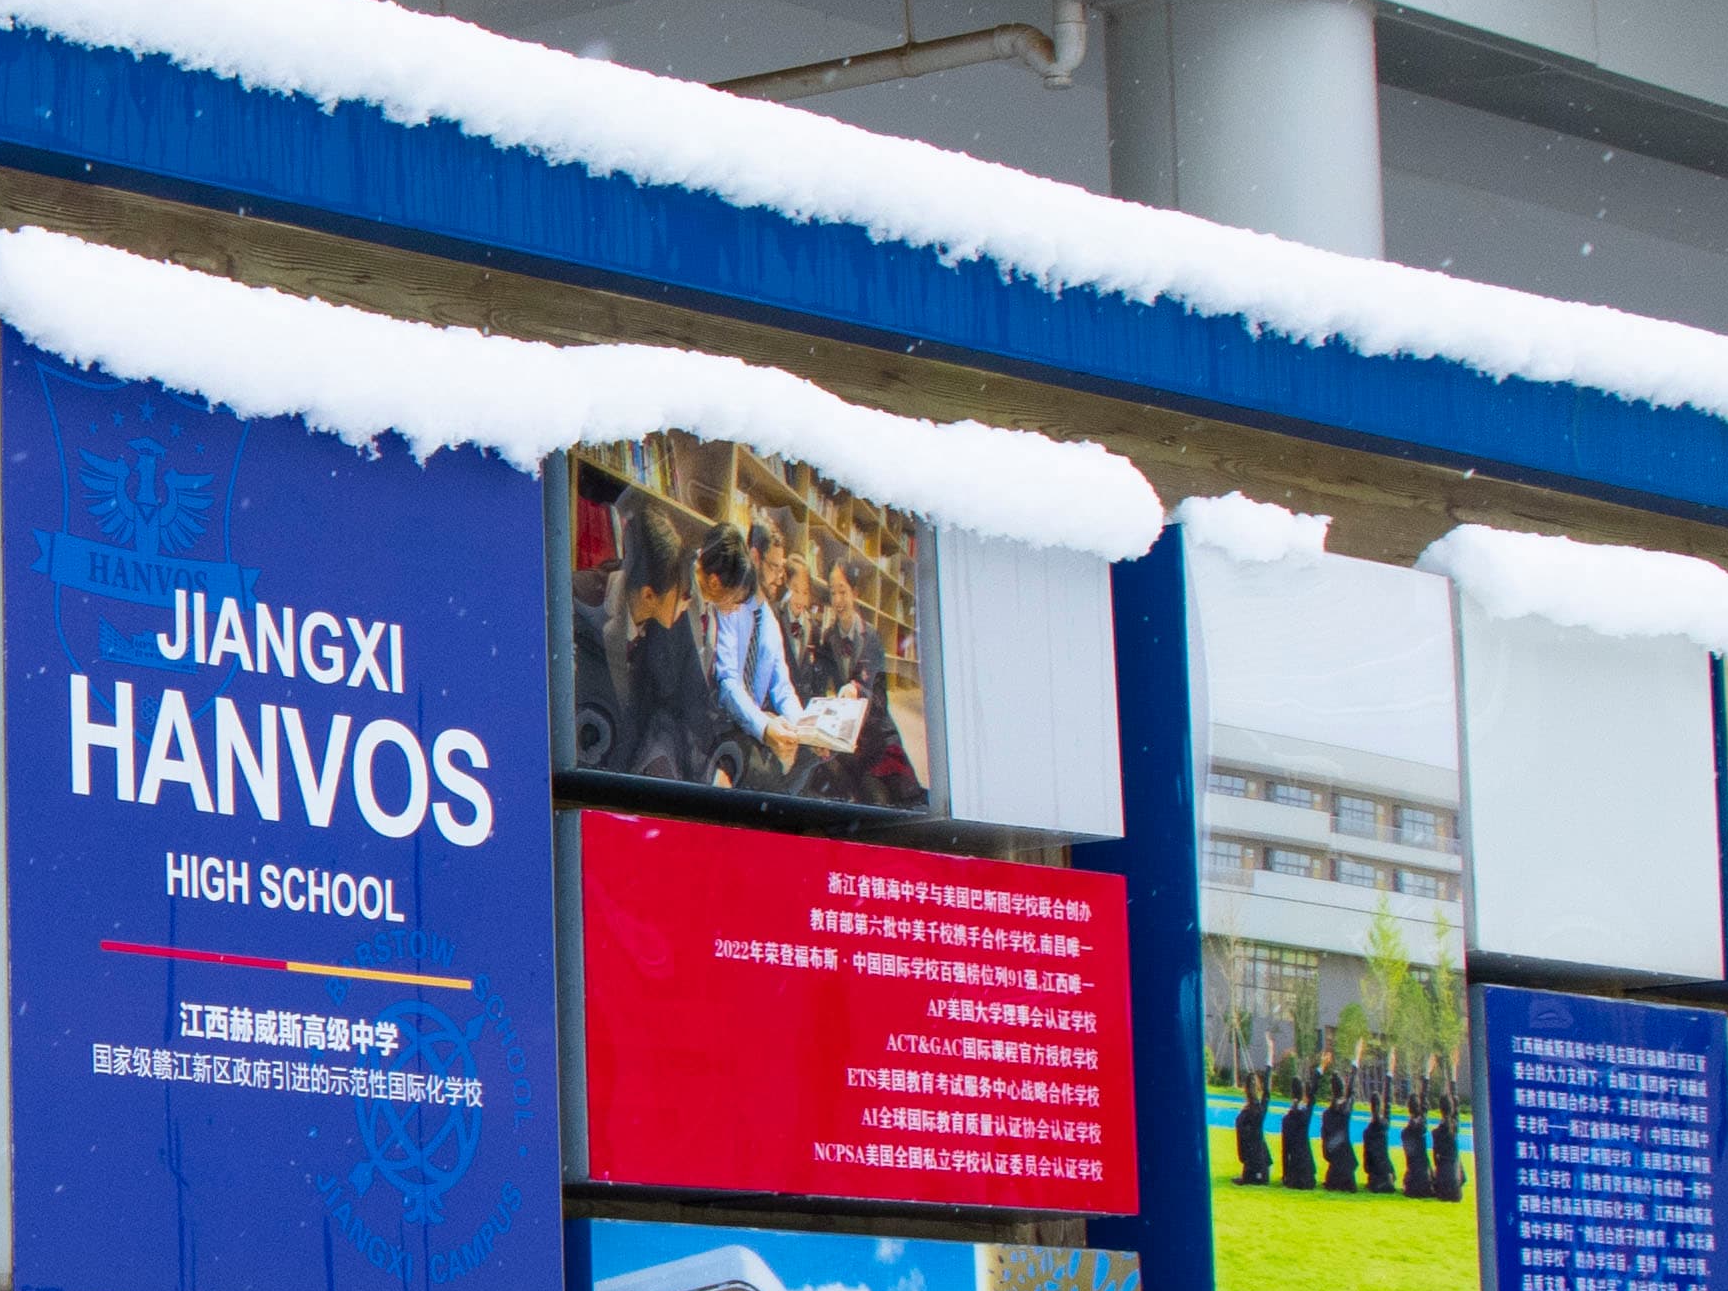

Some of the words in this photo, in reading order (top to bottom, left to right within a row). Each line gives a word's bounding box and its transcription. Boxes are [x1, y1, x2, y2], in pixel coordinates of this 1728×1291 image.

[156, 587, 405, 695] JIANGXI
[68, 673, 495, 848] HANVOS
[165, 851, 250, 906] HIGH
[260, 864, 406, 924] SCHOOL
[179, 1001, 400, 1057] 江西赫威斯高级中学
[92, 1042, 484, 1108] 国家级赣江新区政府引进的示范性国际化学校
